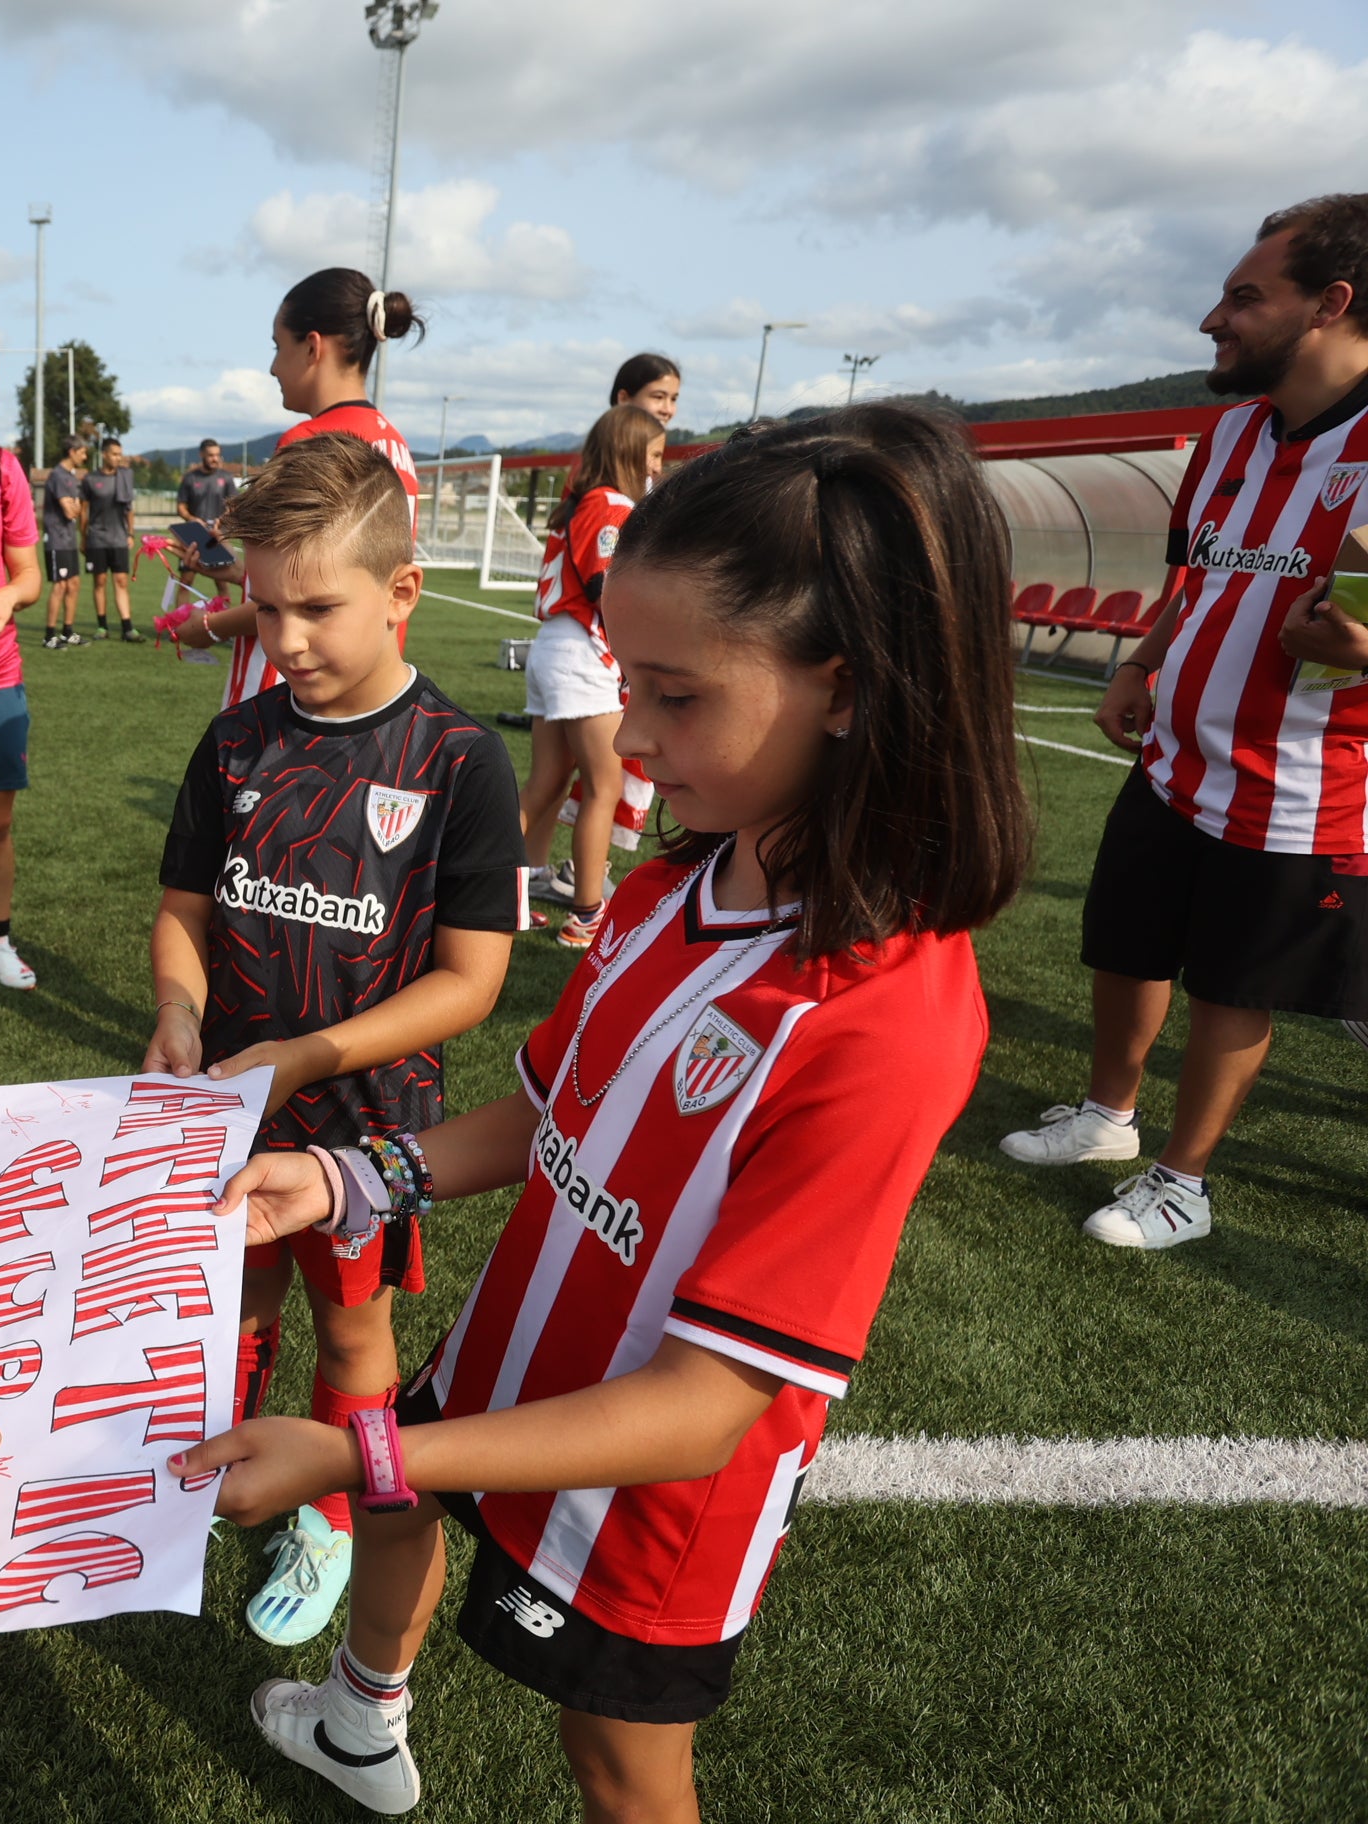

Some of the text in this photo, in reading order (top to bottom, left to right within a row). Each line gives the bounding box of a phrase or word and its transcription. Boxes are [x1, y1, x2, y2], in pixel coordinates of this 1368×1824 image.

[1190, 523, 1308, 575] Kutxabank
[216, 858, 386, 932] Kutxabank
[706, 1011, 757, 1057] ATHLETIC CLUB
[387, 1706, 405, 1728] NIKE
